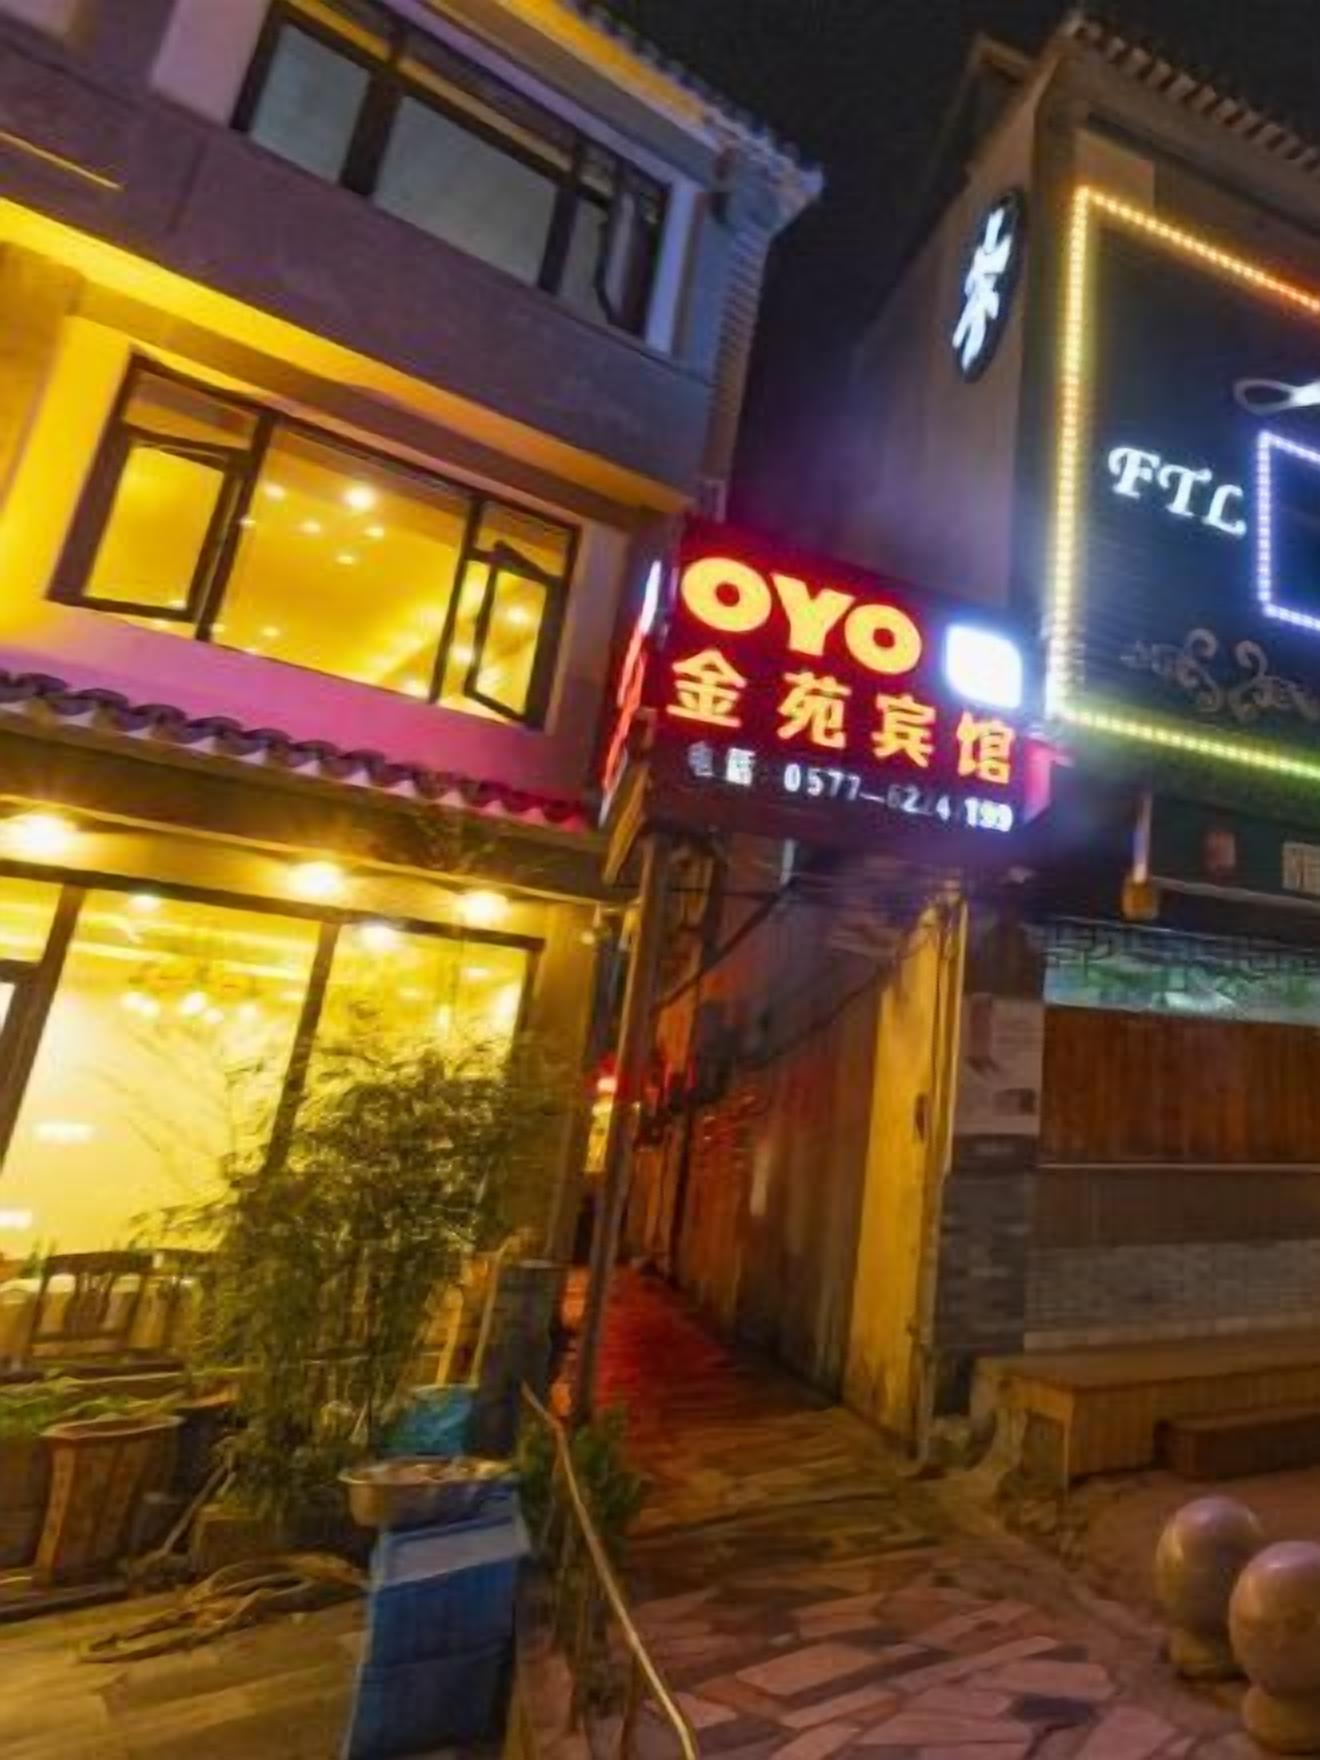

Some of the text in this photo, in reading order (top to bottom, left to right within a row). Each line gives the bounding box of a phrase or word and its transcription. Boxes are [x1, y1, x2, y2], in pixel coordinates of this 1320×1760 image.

[1108, 446, 1246, 536] FTL
[680, 556, 923, 676] OYO
[666, 649, 1017, 785] 金苑宾馆
